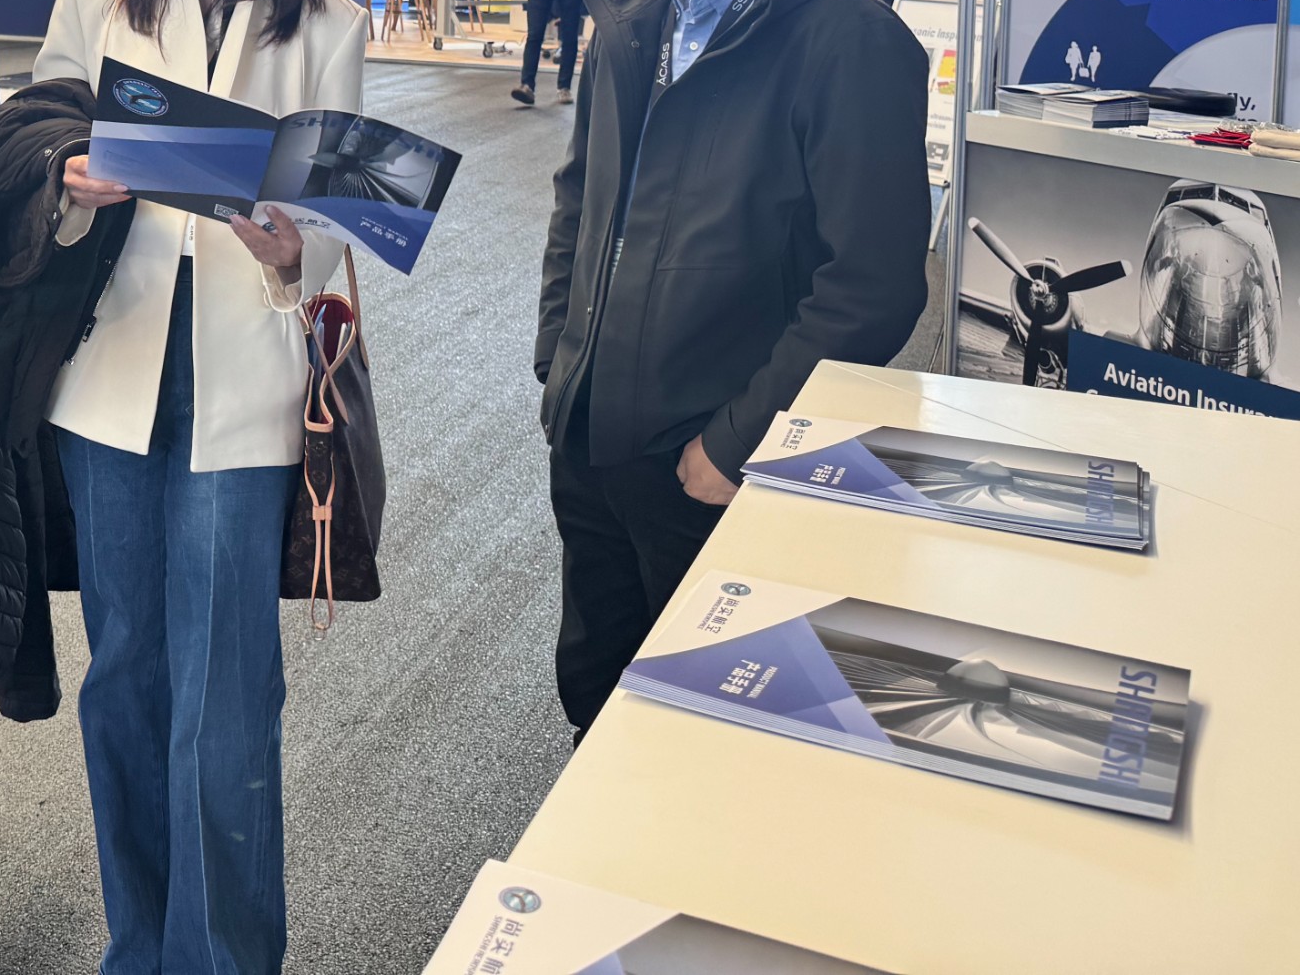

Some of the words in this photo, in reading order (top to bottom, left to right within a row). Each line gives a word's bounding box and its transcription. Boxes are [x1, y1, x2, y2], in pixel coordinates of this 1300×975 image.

[657, 41, 671, 86] ACASS
[1103, 362, 1190, 406] Aviation
[719, 659, 761, 695] 产品手册
